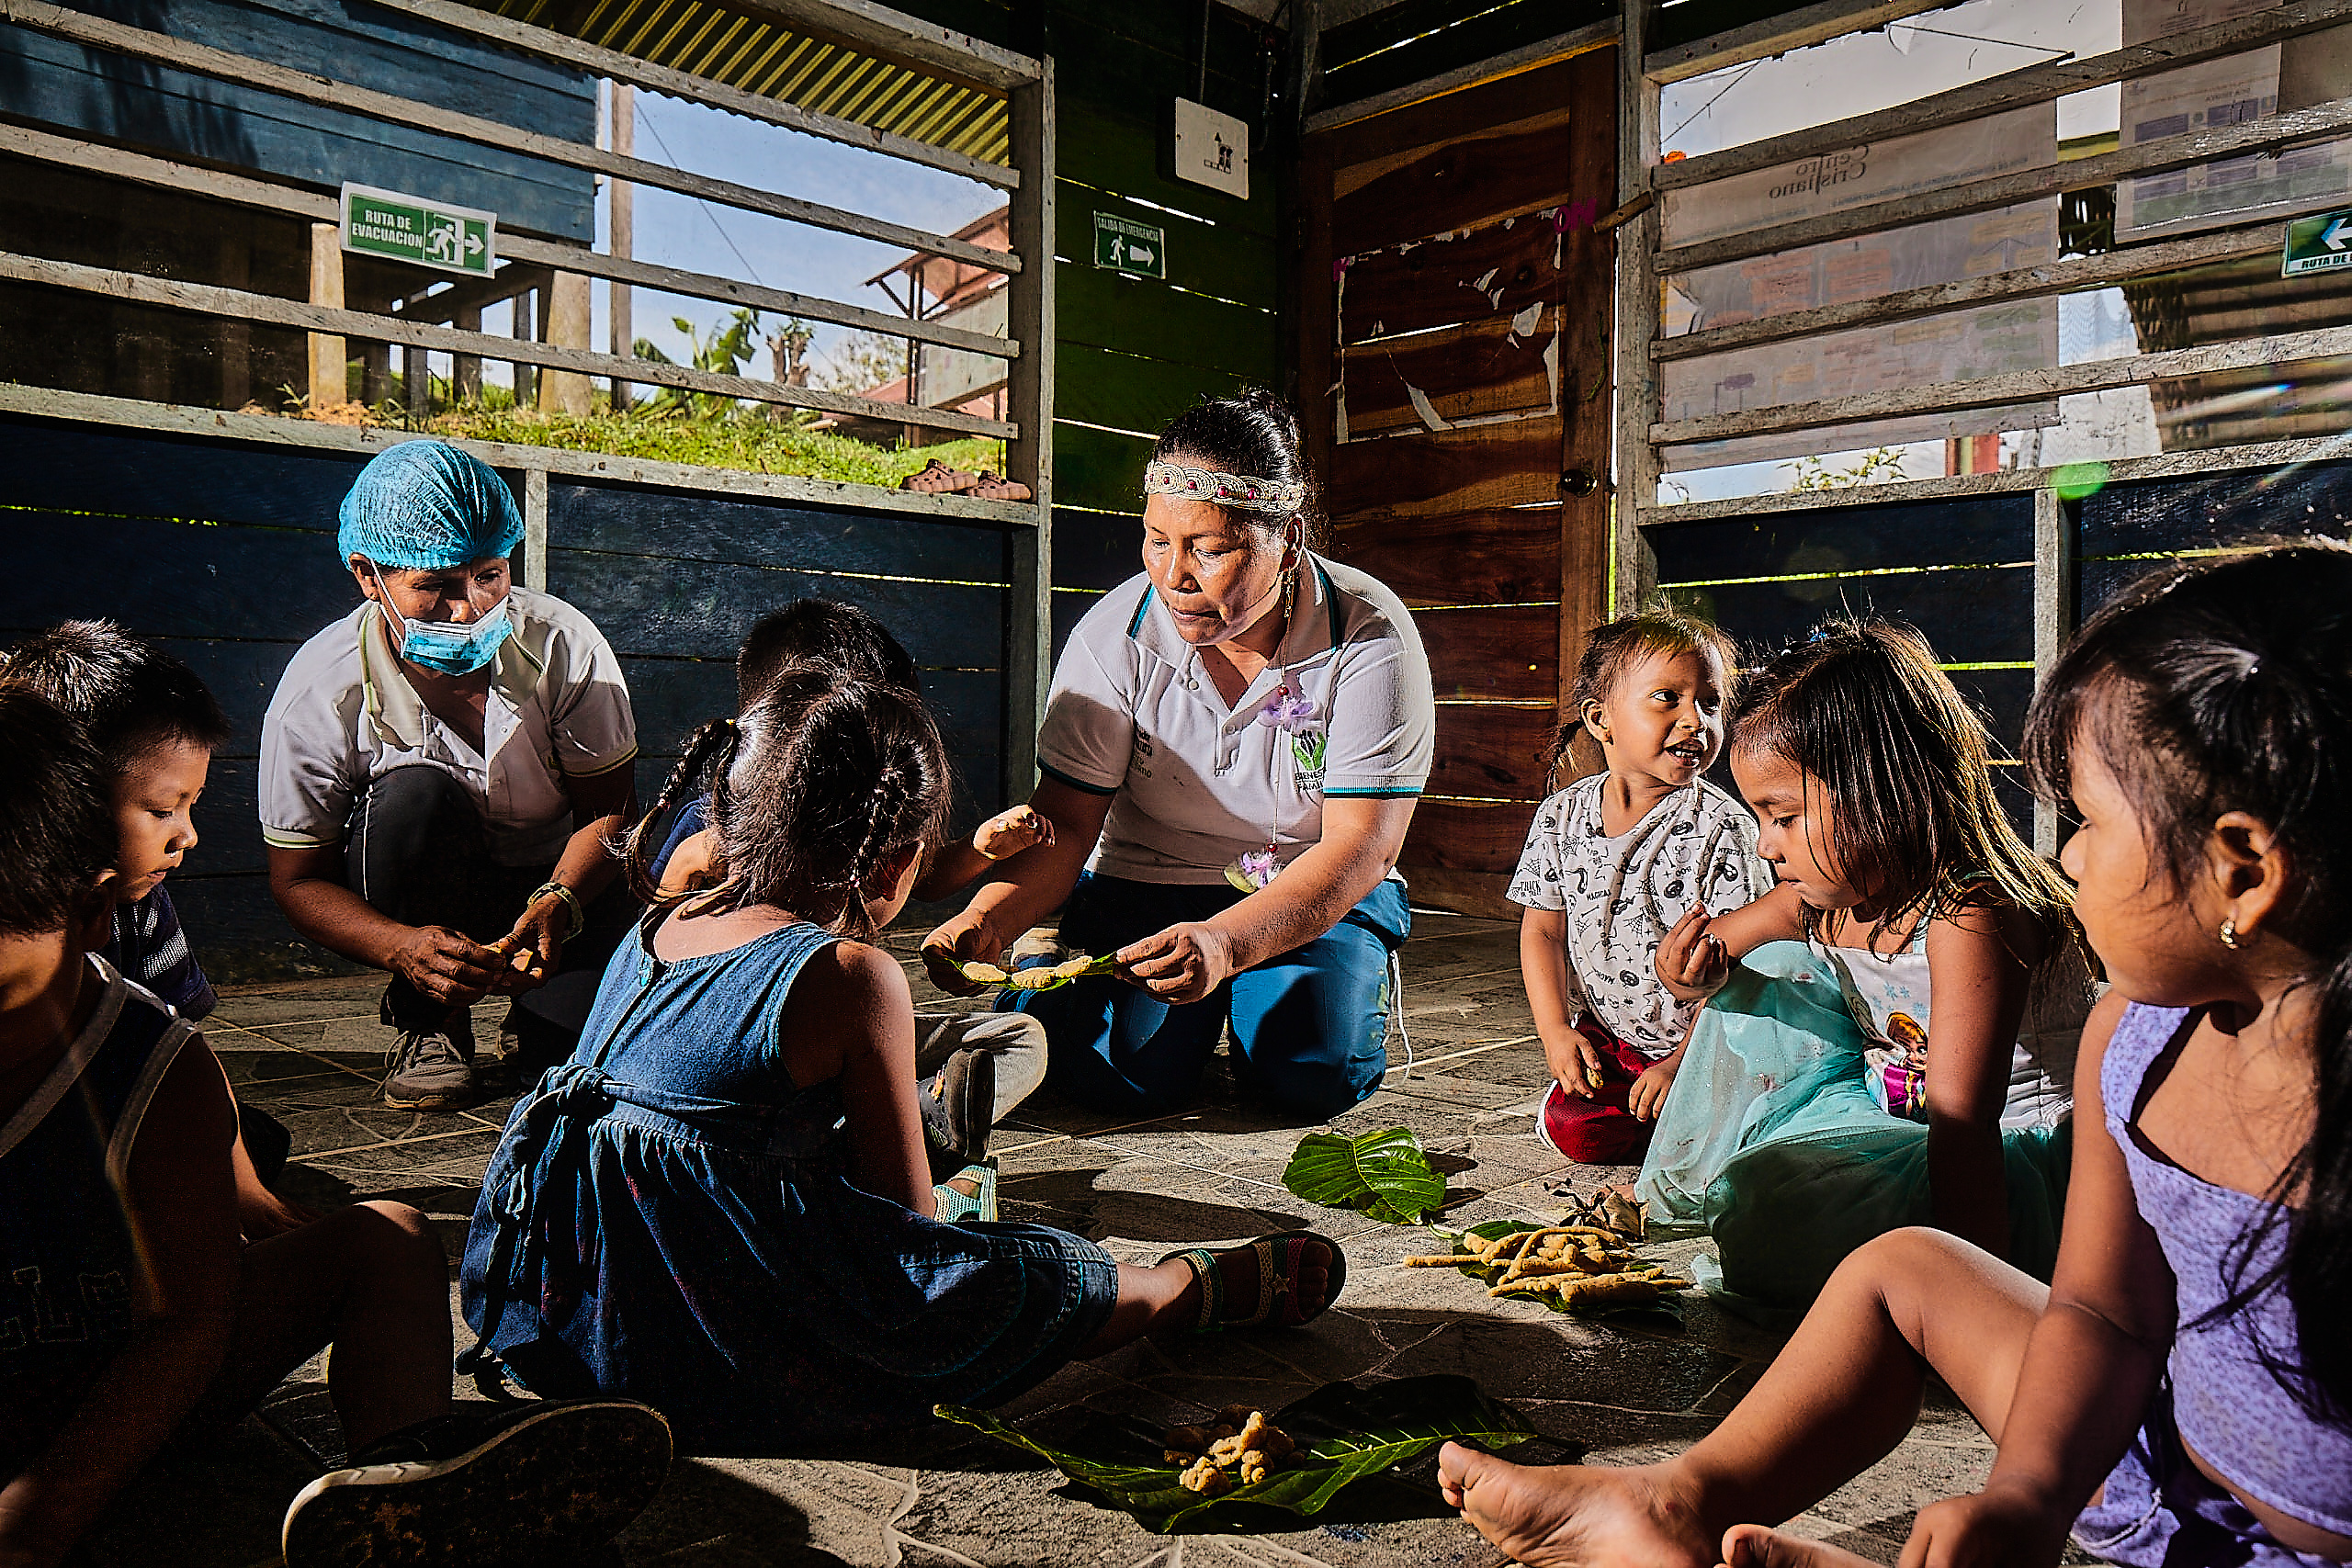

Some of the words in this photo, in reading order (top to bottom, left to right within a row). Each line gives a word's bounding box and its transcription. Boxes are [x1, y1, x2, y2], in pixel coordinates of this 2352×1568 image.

[365, 209, 395, 228] RUTA
[397, 215, 412, 231] DE
[353, 222, 423, 248] EVACUACION
[2301, 256, 2330, 269] RUTA
[2333, 254, 2347, 265] DE
